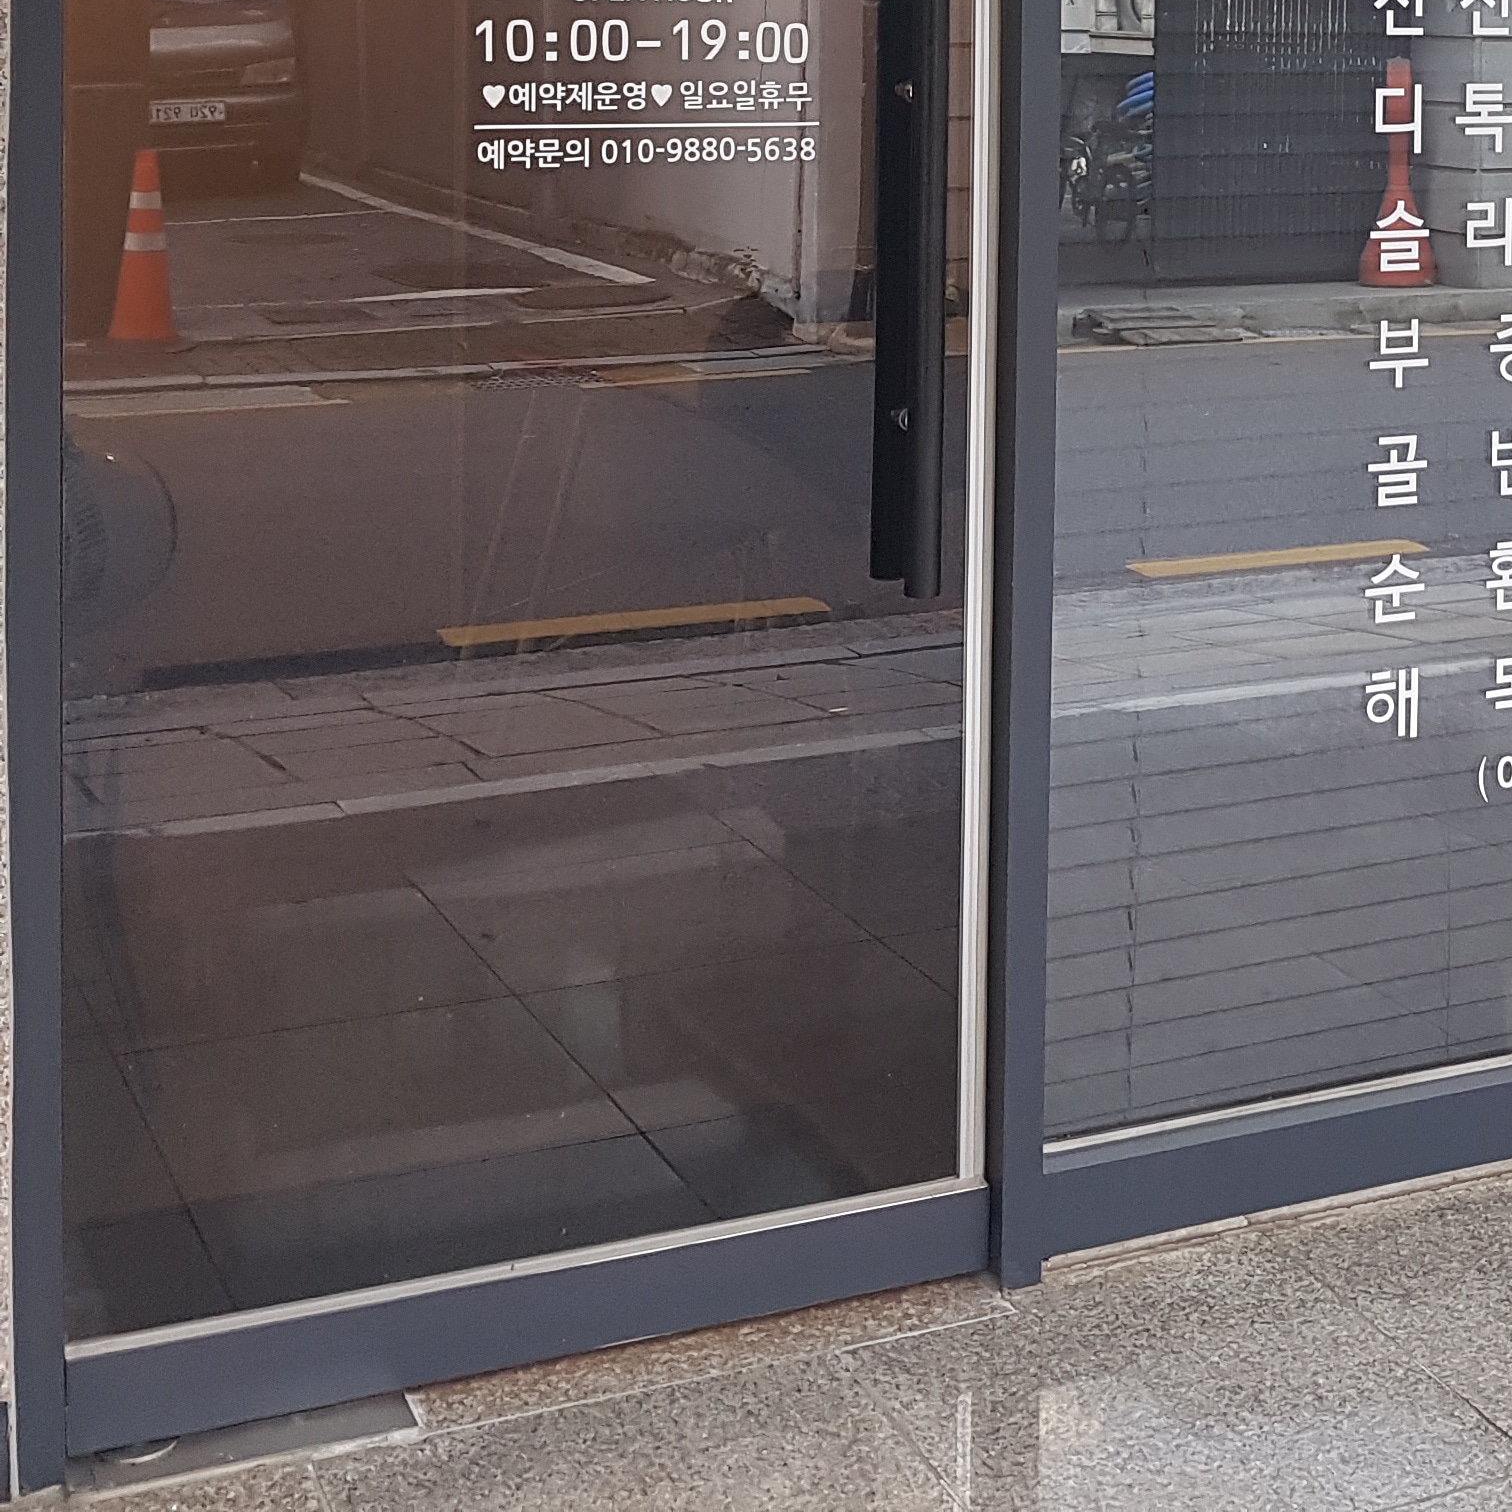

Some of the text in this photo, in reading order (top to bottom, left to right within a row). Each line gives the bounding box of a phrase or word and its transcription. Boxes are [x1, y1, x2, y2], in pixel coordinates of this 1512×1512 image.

[680, 79, 813, 111] 일요일휴무
[477, 136, 816, 170] 예약문의 010-9880-5638
